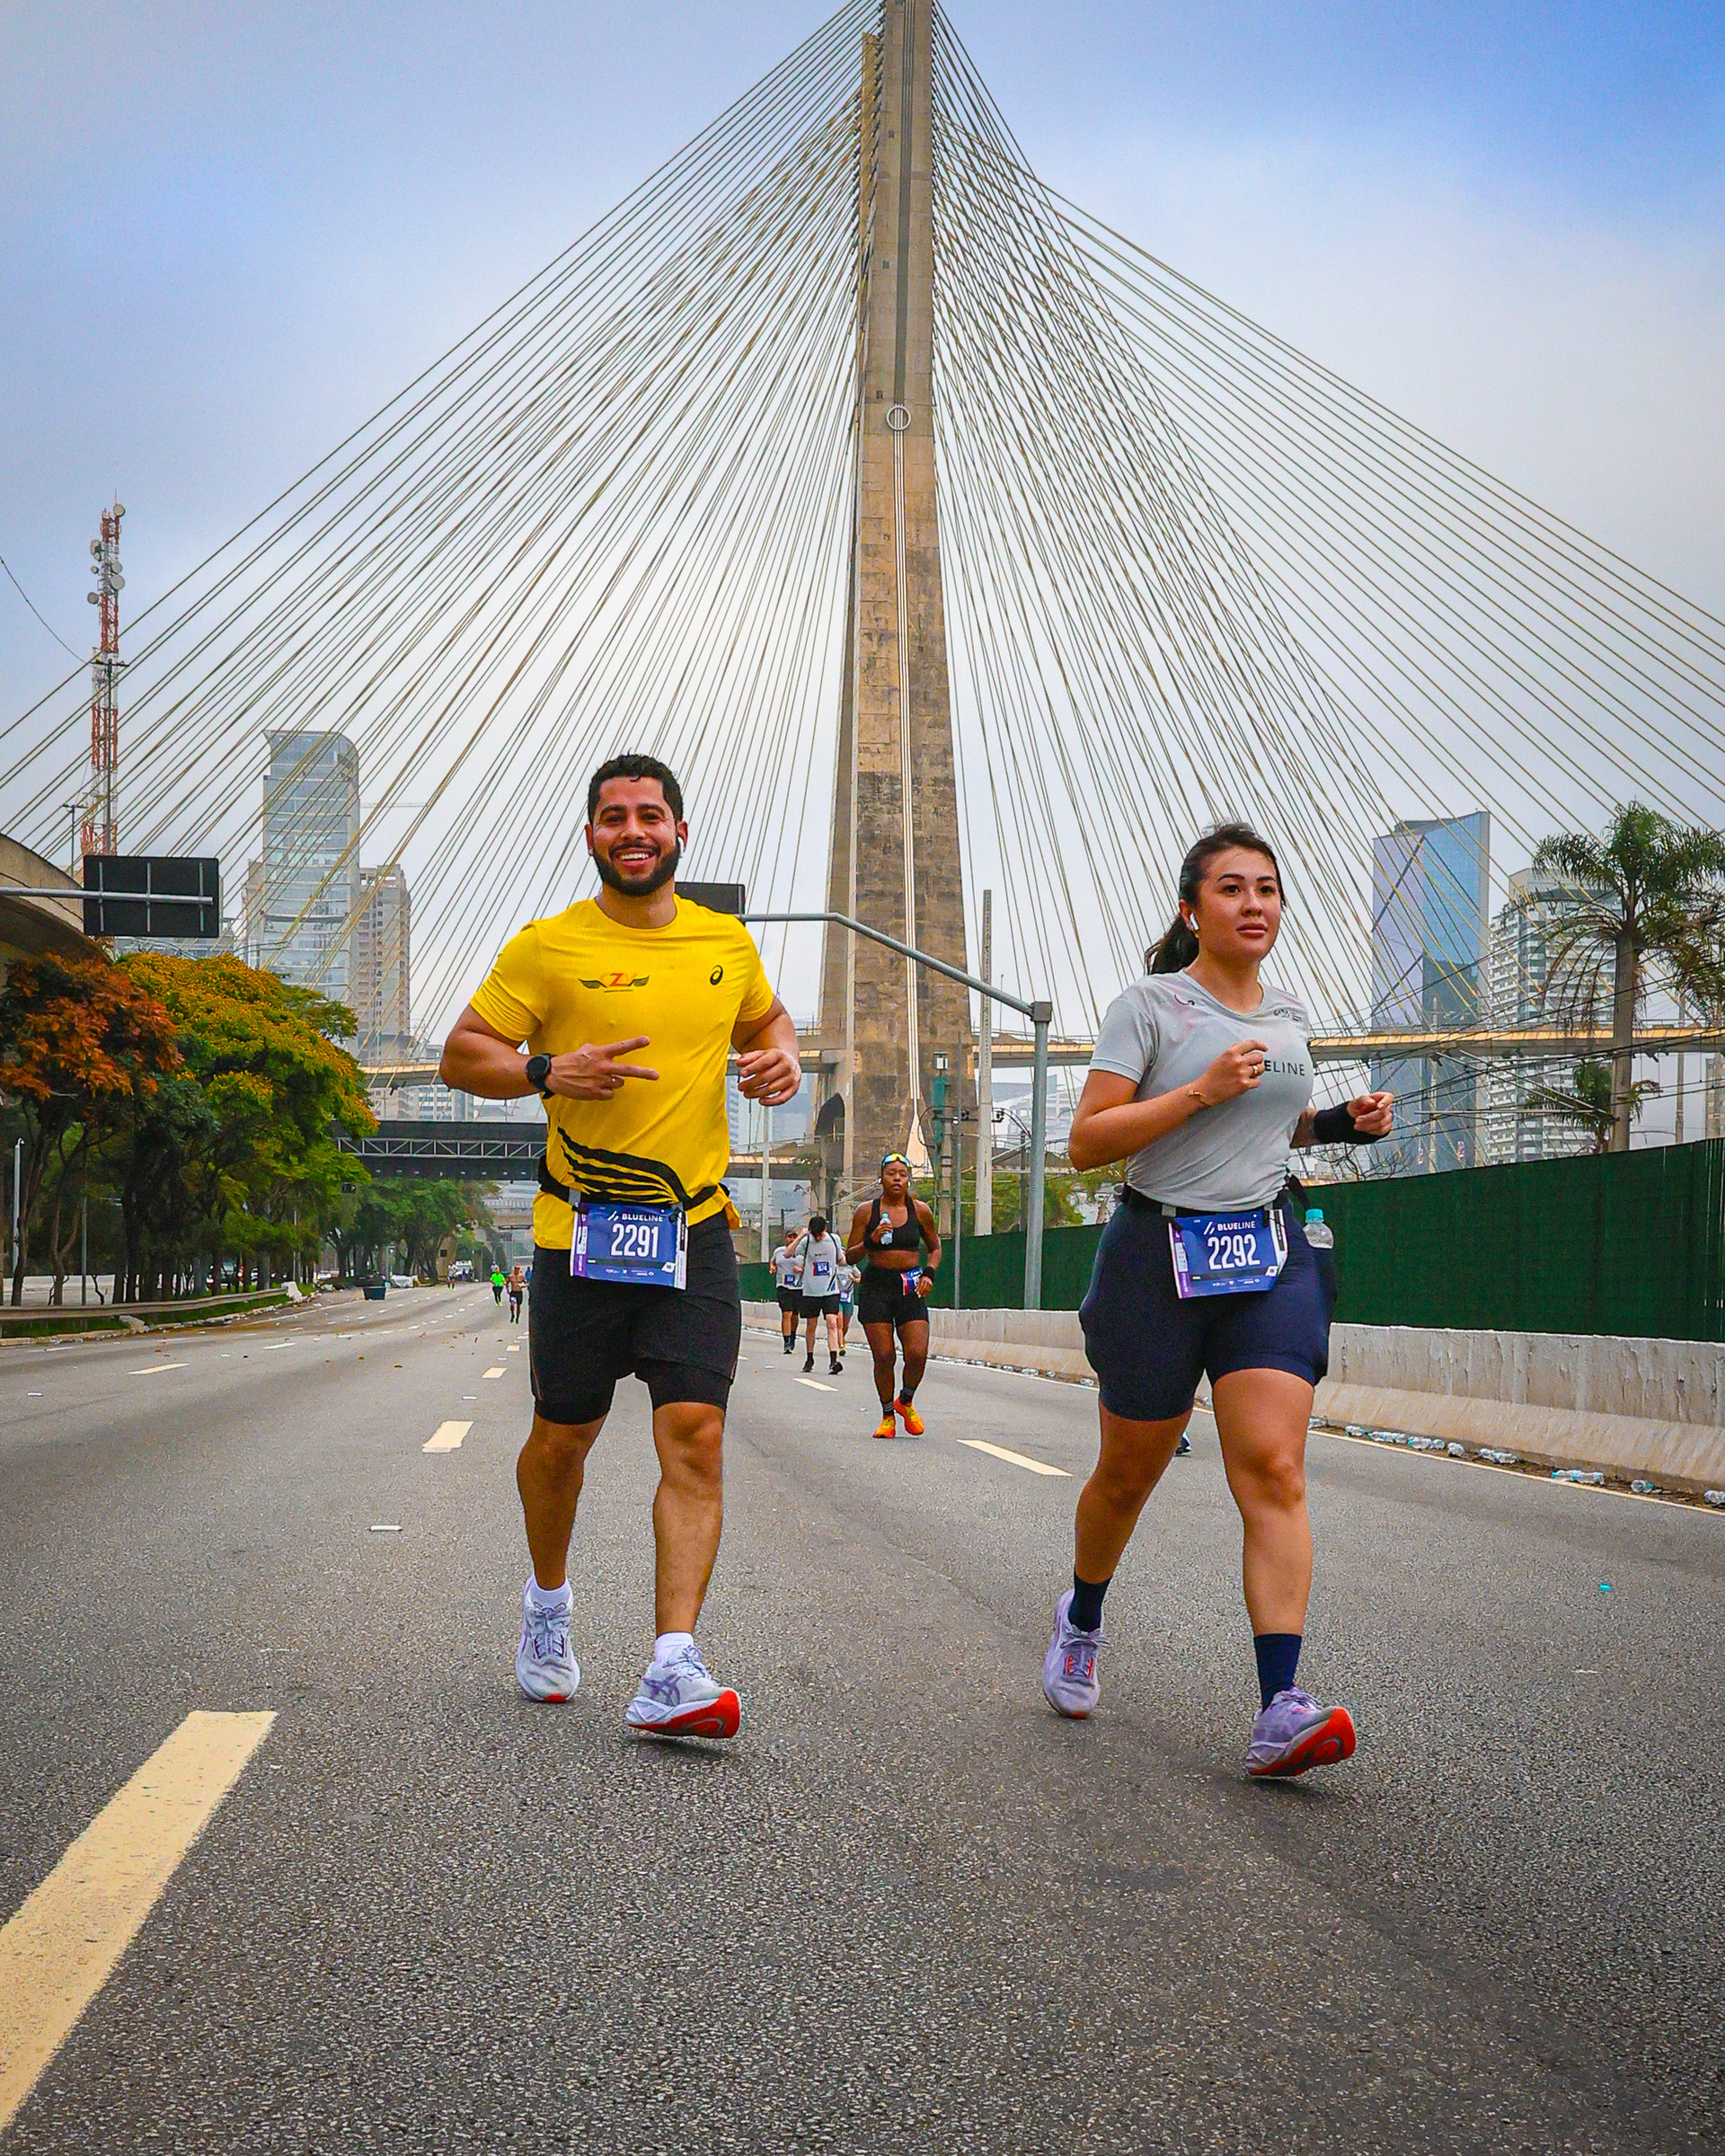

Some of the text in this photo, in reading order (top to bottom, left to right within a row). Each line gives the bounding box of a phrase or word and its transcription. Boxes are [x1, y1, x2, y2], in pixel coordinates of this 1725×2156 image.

[1264, 1060, 1305, 1076] ELINE
[622, 1213, 664, 1223] BLUELINE
[1217, 1221, 1257, 1232] BLUELINE
[611, 1223, 659, 1259] 2291
[1208, 1233, 1261, 1270] 2292
